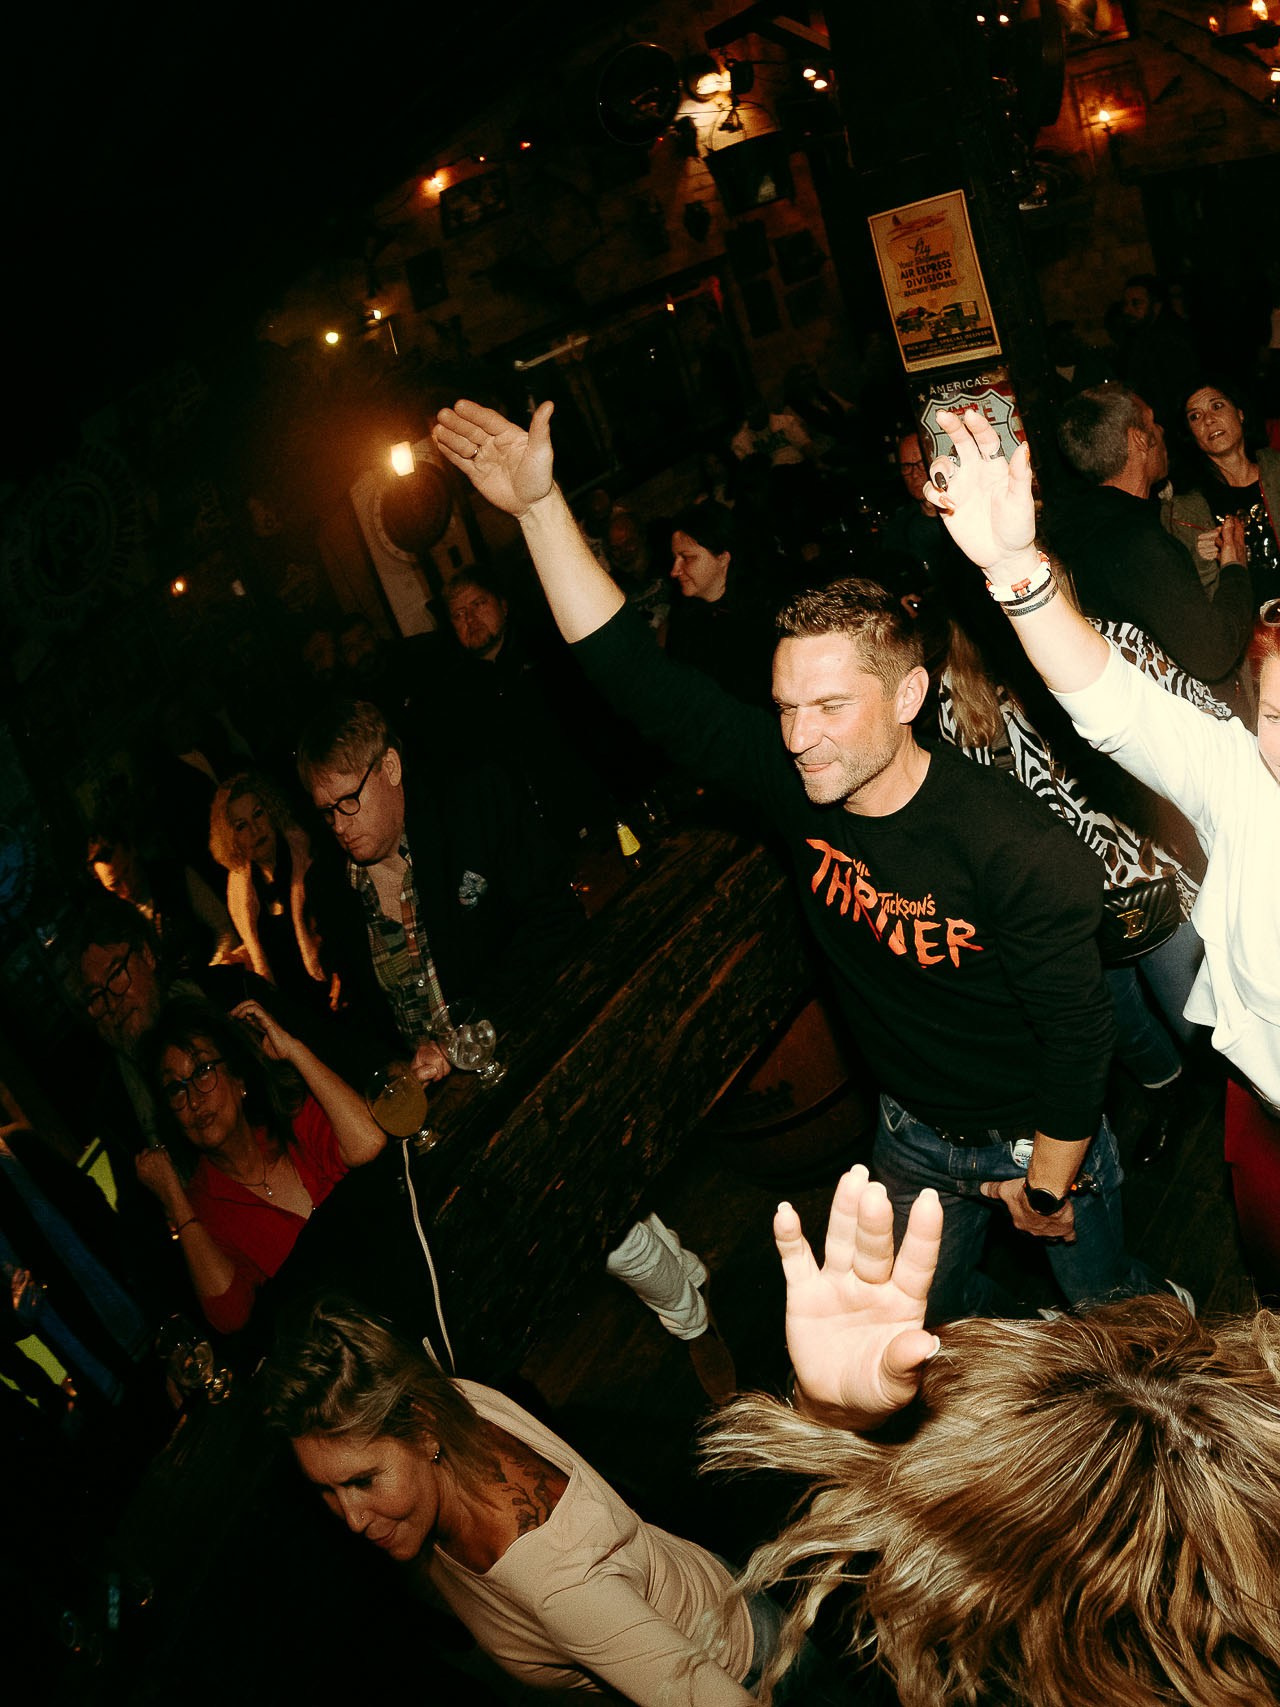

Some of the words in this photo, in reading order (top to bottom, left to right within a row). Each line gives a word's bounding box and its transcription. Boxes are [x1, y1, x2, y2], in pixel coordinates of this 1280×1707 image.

[907, 237, 931, 257] Fly
[900, 269, 916, 280] AIR
[916, 259, 953, 275] EXPRESS
[906, 270, 952, 289] DIVISION
[929, 375, 990, 396] AMERICA'S
